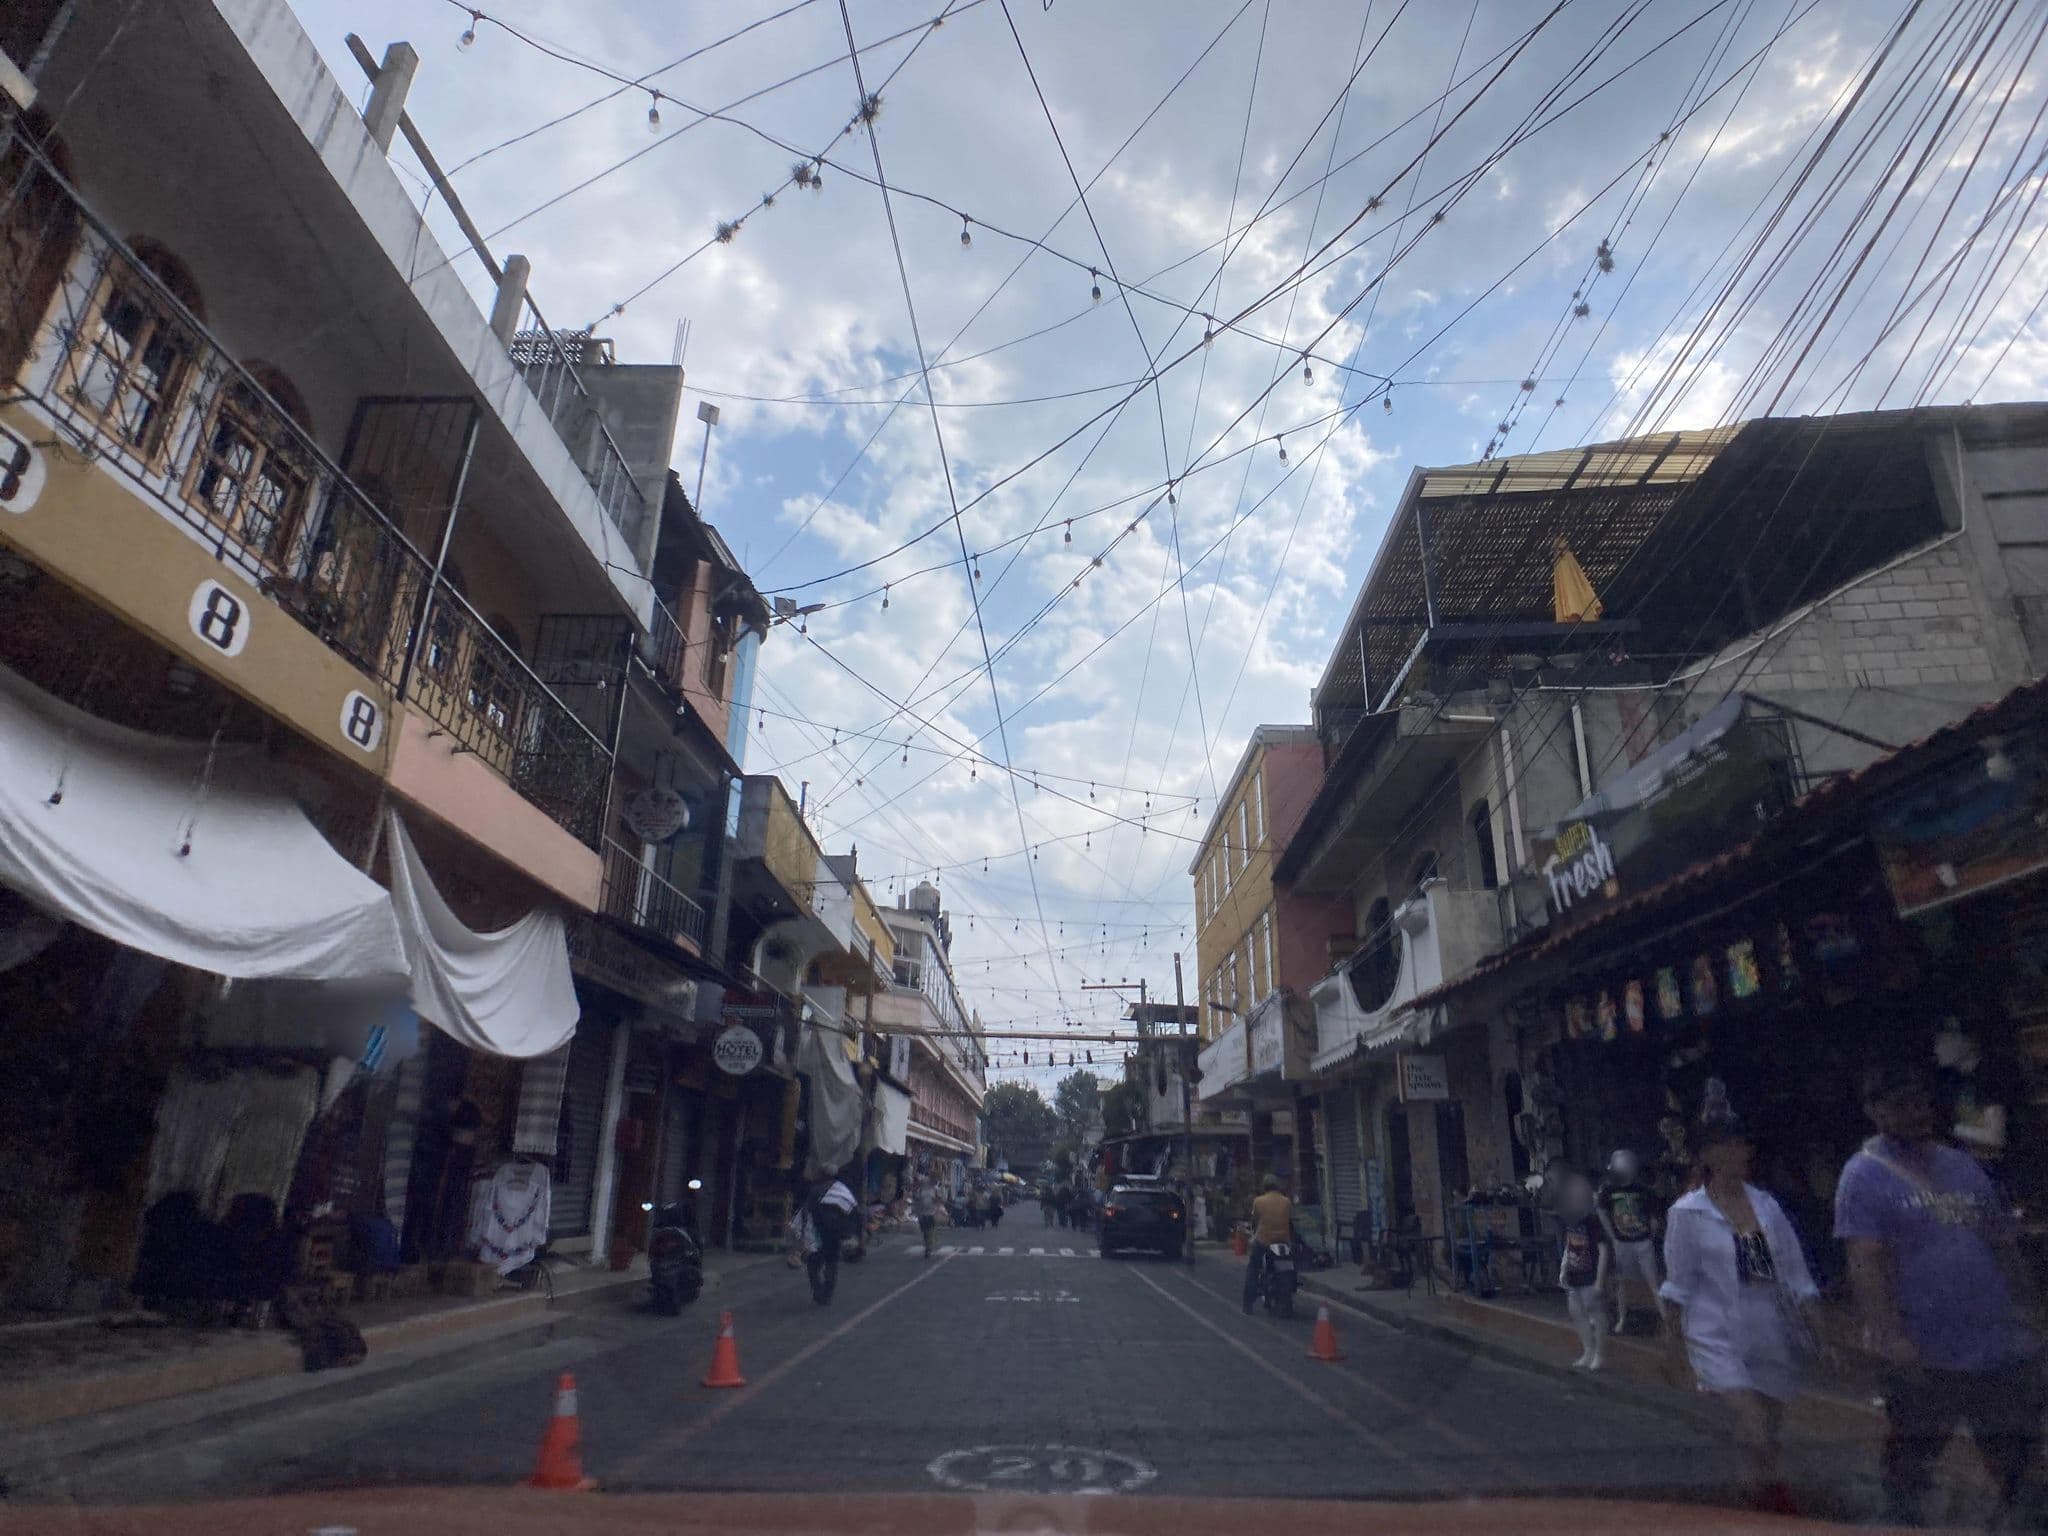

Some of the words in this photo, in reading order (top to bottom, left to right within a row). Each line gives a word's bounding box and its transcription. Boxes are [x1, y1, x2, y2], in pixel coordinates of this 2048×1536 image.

[199, 584, 242, 651] 8
[346, 695, 377, 748] 8
[716, 1043, 759, 1056] HOTEL
